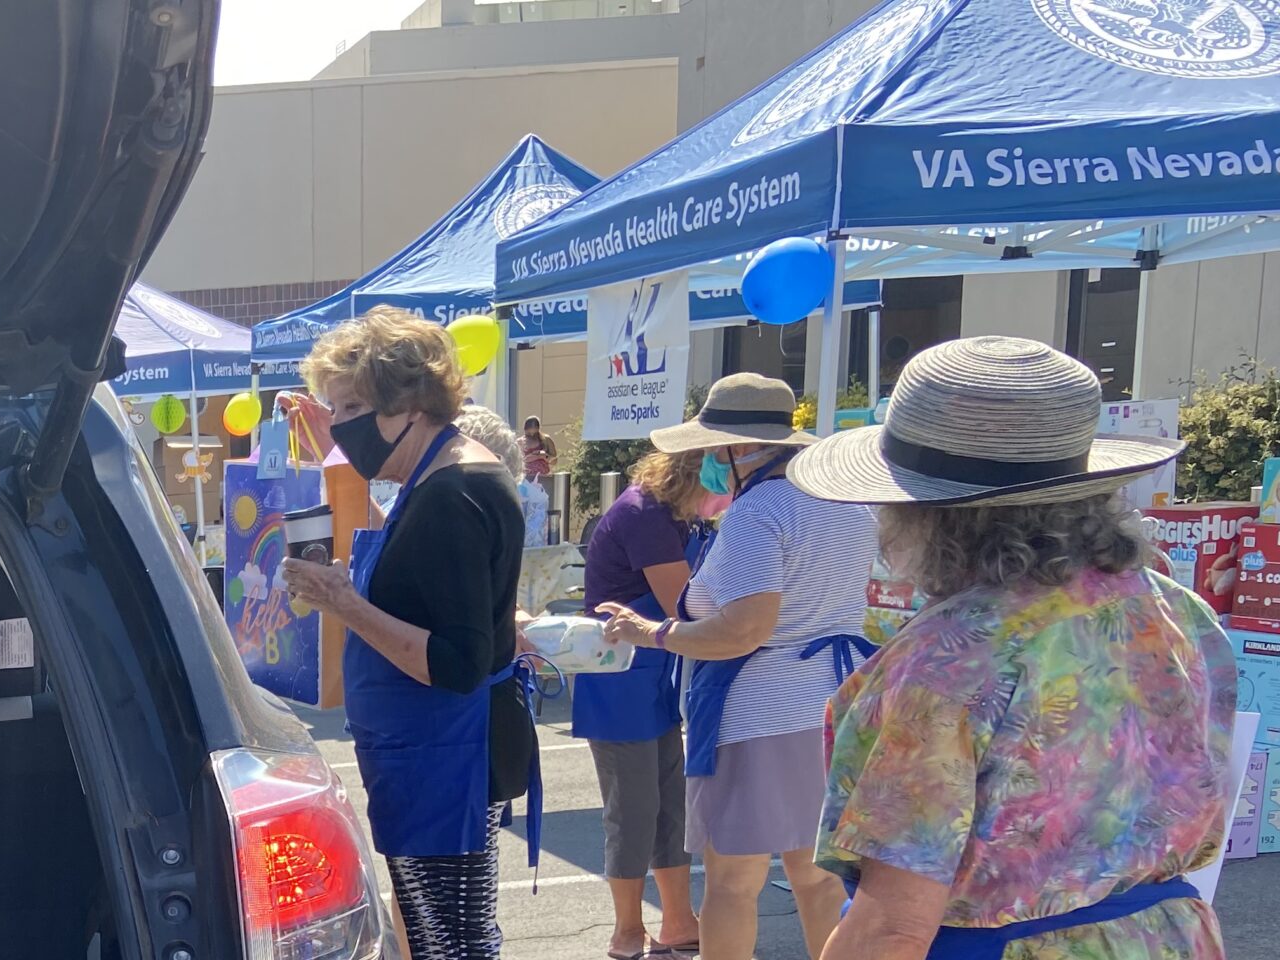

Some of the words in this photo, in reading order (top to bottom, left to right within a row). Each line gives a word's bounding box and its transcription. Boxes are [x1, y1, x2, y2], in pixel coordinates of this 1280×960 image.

[1086, 34, 1158, 64] UNITED
[912, 148, 974, 188] VA
[986, 147, 1118, 187] Sierra
[511, 258, 528, 281] VA
[530, 250, 568, 275] Sierra
[569, 224, 622, 267] Nevada
[625, 203, 678, 249] Health
[681, 196, 722, 232] Care
[726, 171, 800, 227] System
[517, 296, 588, 317] Nevad
[203, 363, 213, 378] VA
[213, 362, 232, 377] Sierra
[232, 361, 251, 377] Nevad
[640, 377, 666, 399] league
[611, 405, 630, 421] Reno
[630, 400, 660, 425] Sparks
[1170, 545, 1196, 562] plus
[1240, 571, 1247, 582] 3
[239, 584, 292, 634] hello
[1261, 836, 1275, 844] 192
